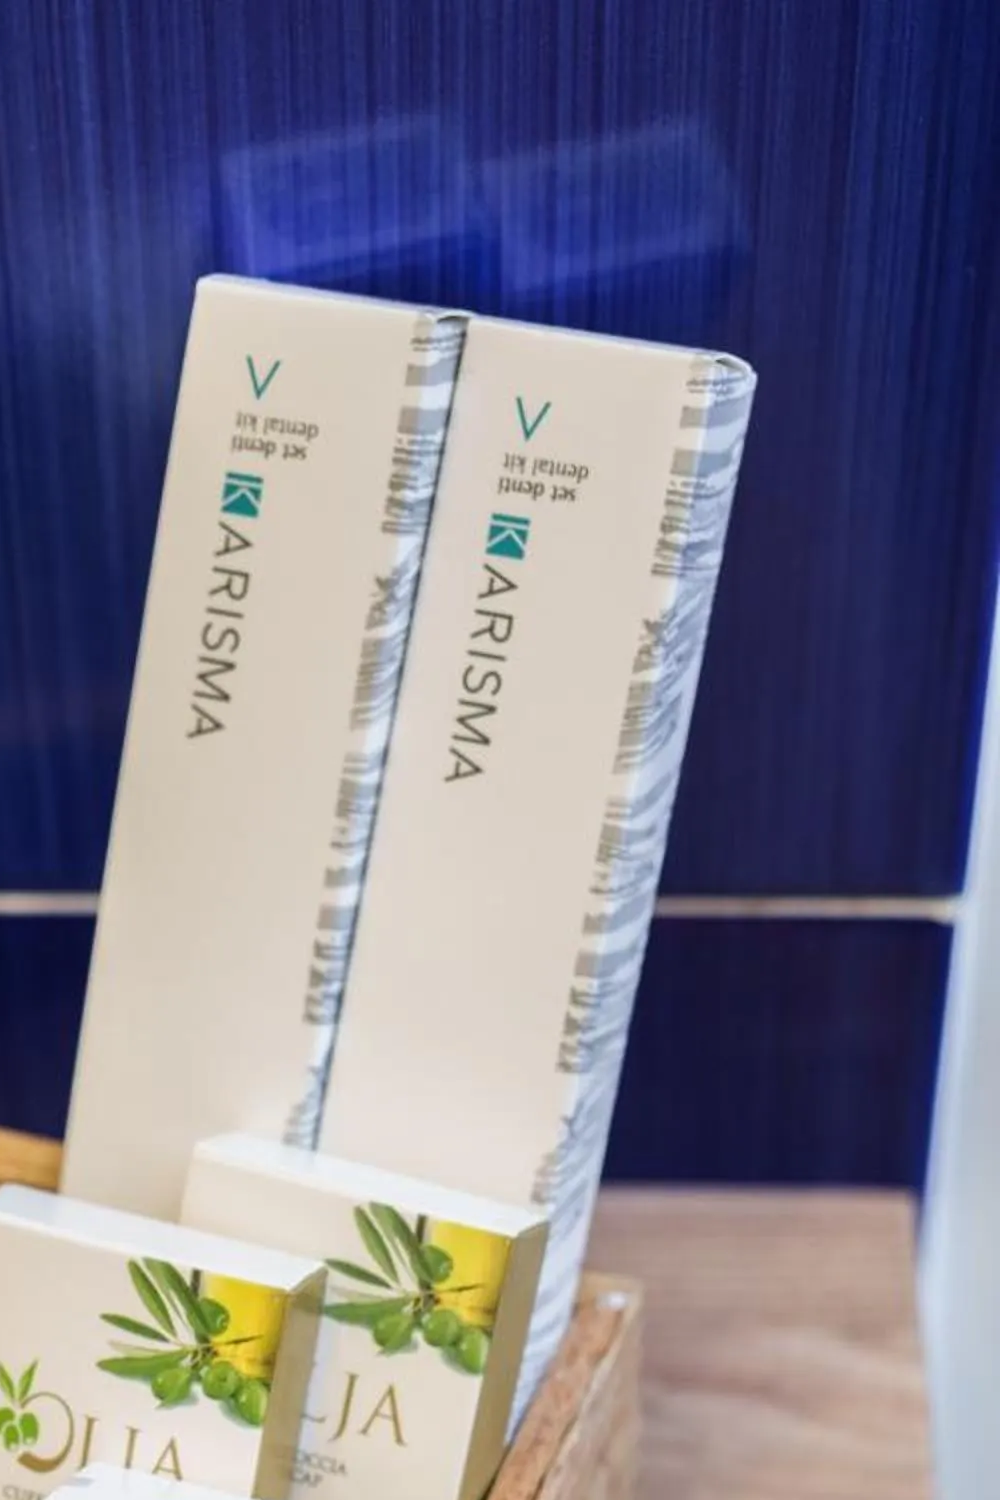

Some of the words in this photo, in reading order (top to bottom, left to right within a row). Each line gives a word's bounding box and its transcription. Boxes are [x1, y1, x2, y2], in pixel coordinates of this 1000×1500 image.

[498, 477, 545, 501] denti
[532, 457, 589, 484] dental
[551, 484, 577, 501] set
[187, 471, 264, 740] KARISMA
[444, 512, 531, 783] KARISMA
[301, 1371, 408, 1447] JA
